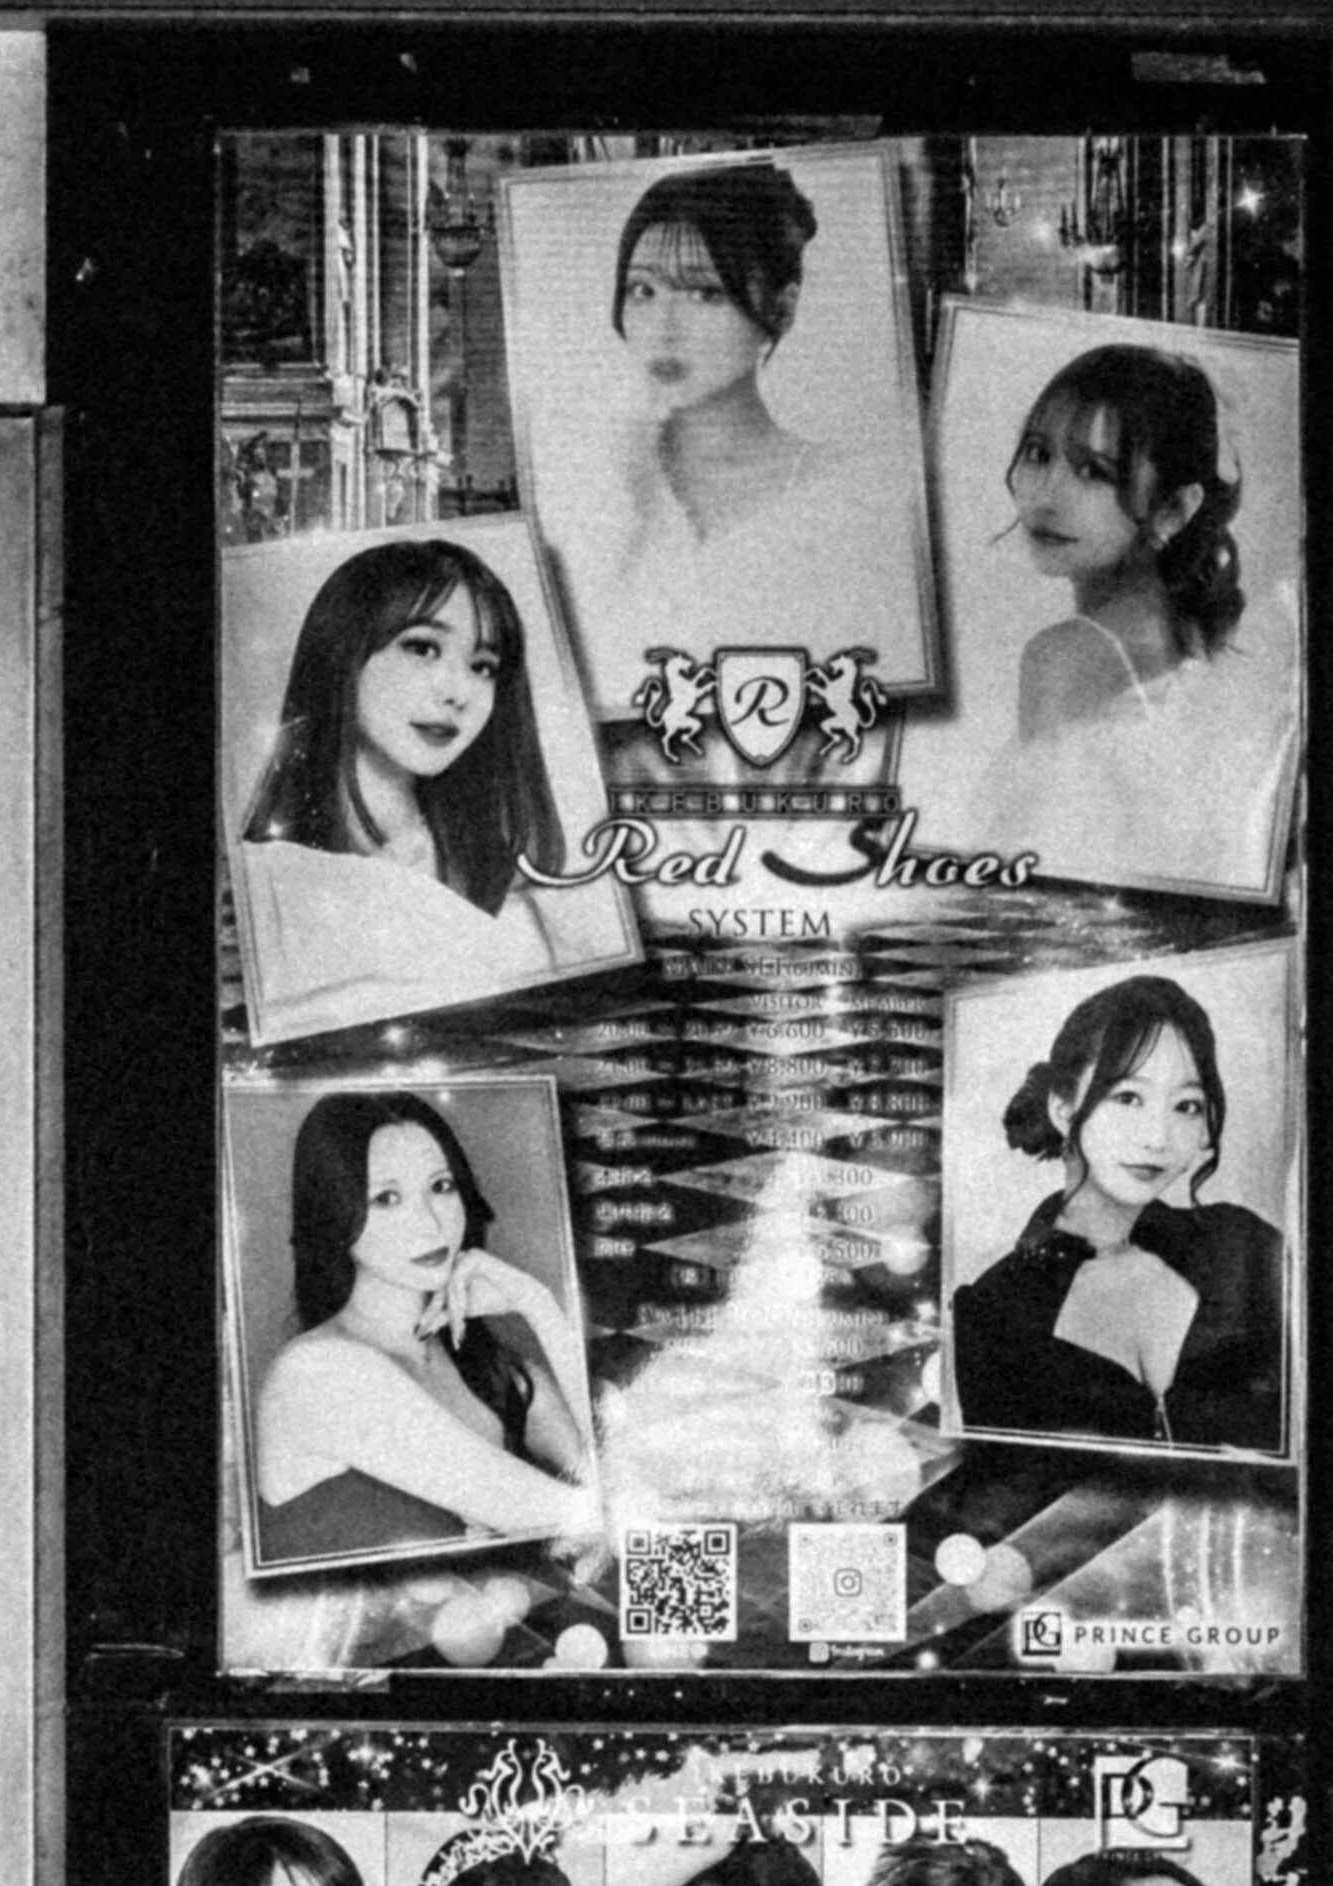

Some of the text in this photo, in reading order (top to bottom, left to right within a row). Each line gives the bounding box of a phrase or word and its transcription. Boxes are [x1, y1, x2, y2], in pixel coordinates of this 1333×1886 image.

[614, 792, 899, 813] IKEBUKURO
[518, 809, 1039, 888] Red Shoes
[689, 909, 831, 938] SYSTEM
[1075, 1626, 1172, 1647] PRINCE
[1187, 1626, 1282, 1648] GROUP
[627, 1797, 967, 1845] SEASIDE
